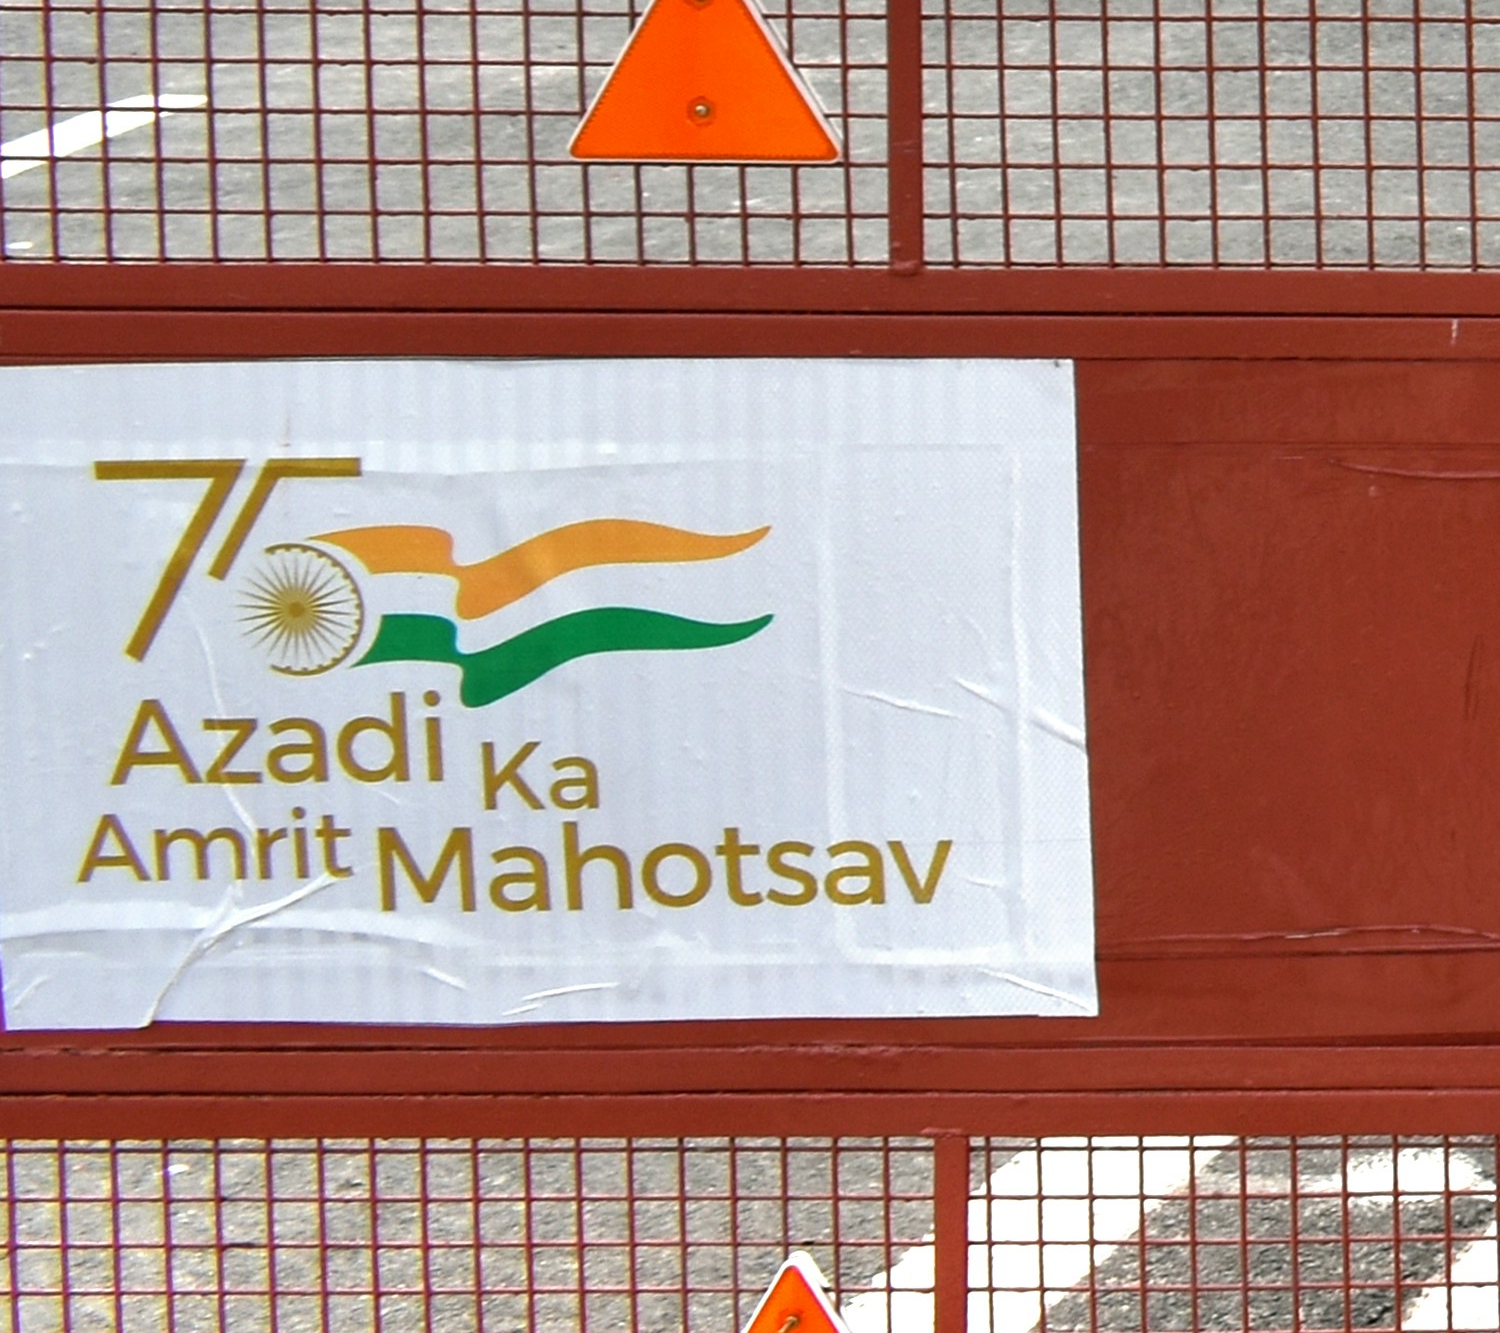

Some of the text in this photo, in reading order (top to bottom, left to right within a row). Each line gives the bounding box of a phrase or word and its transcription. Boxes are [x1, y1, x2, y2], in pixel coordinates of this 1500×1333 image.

[109, 691, 601, 811] Azadi Ka
[76, 807, 953, 913] Amrit Mahotsav
